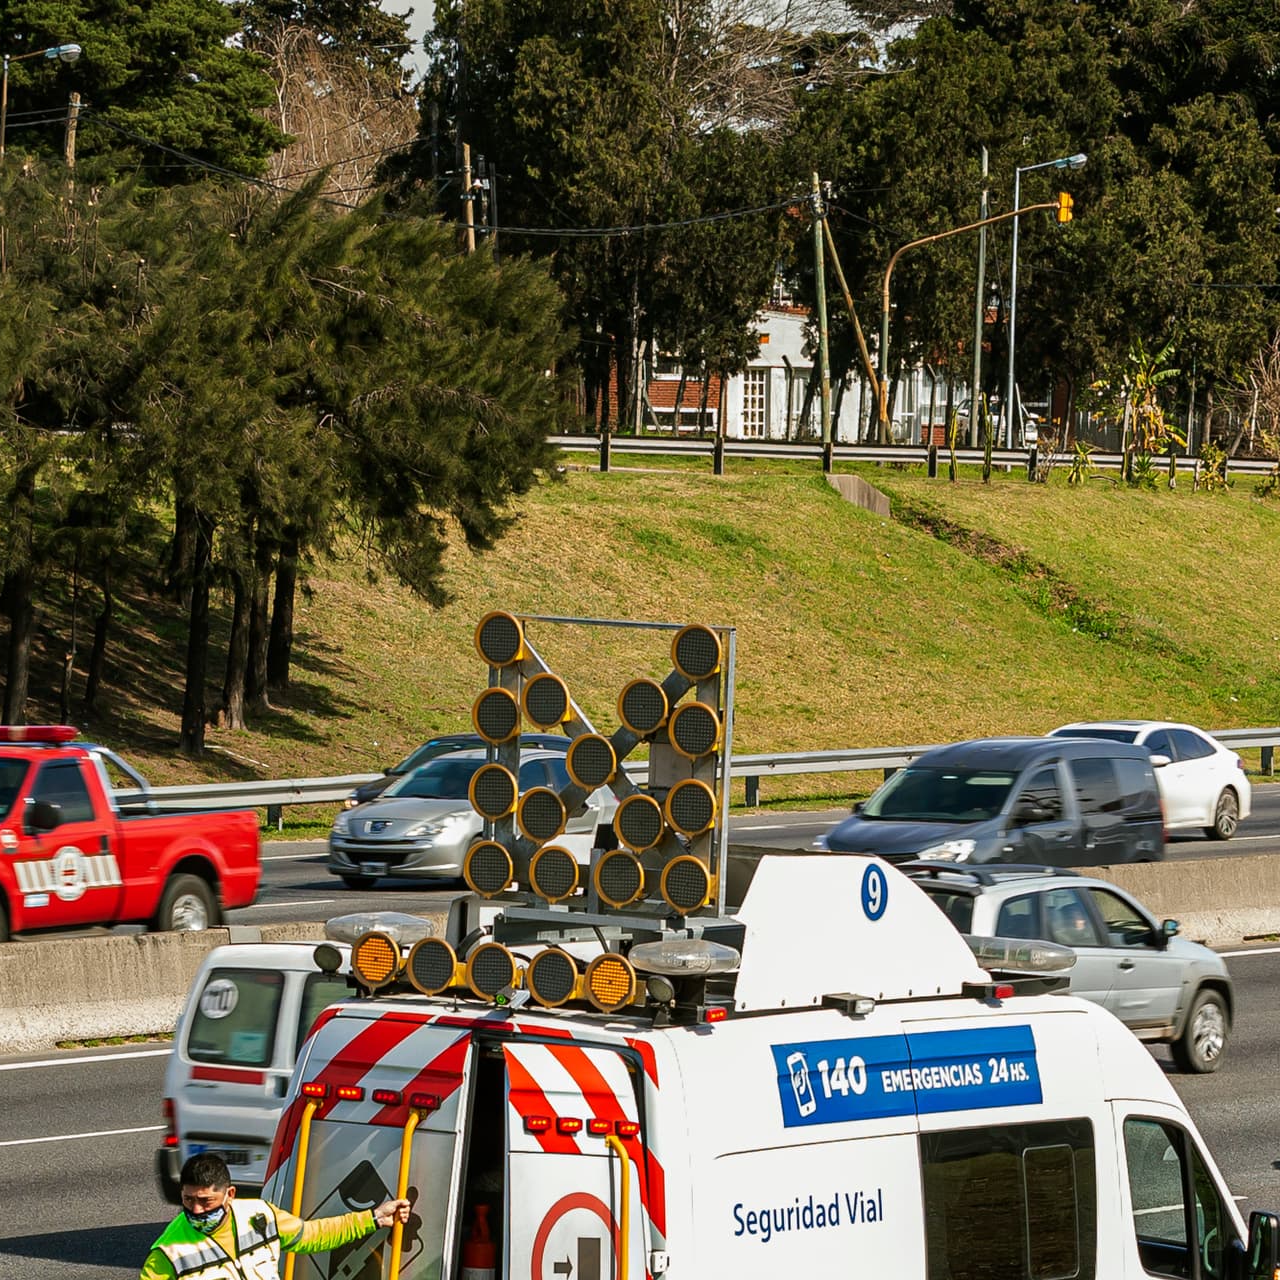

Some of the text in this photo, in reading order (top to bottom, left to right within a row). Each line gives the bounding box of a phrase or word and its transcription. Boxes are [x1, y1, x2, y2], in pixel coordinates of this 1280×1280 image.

[868, 870, 882, 914] 9
[817, 1055, 868, 1099] 140
[881, 1062, 984, 1093] EMERGENCIAS
[733, 1187, 883, 1243] Seguridad Vial
